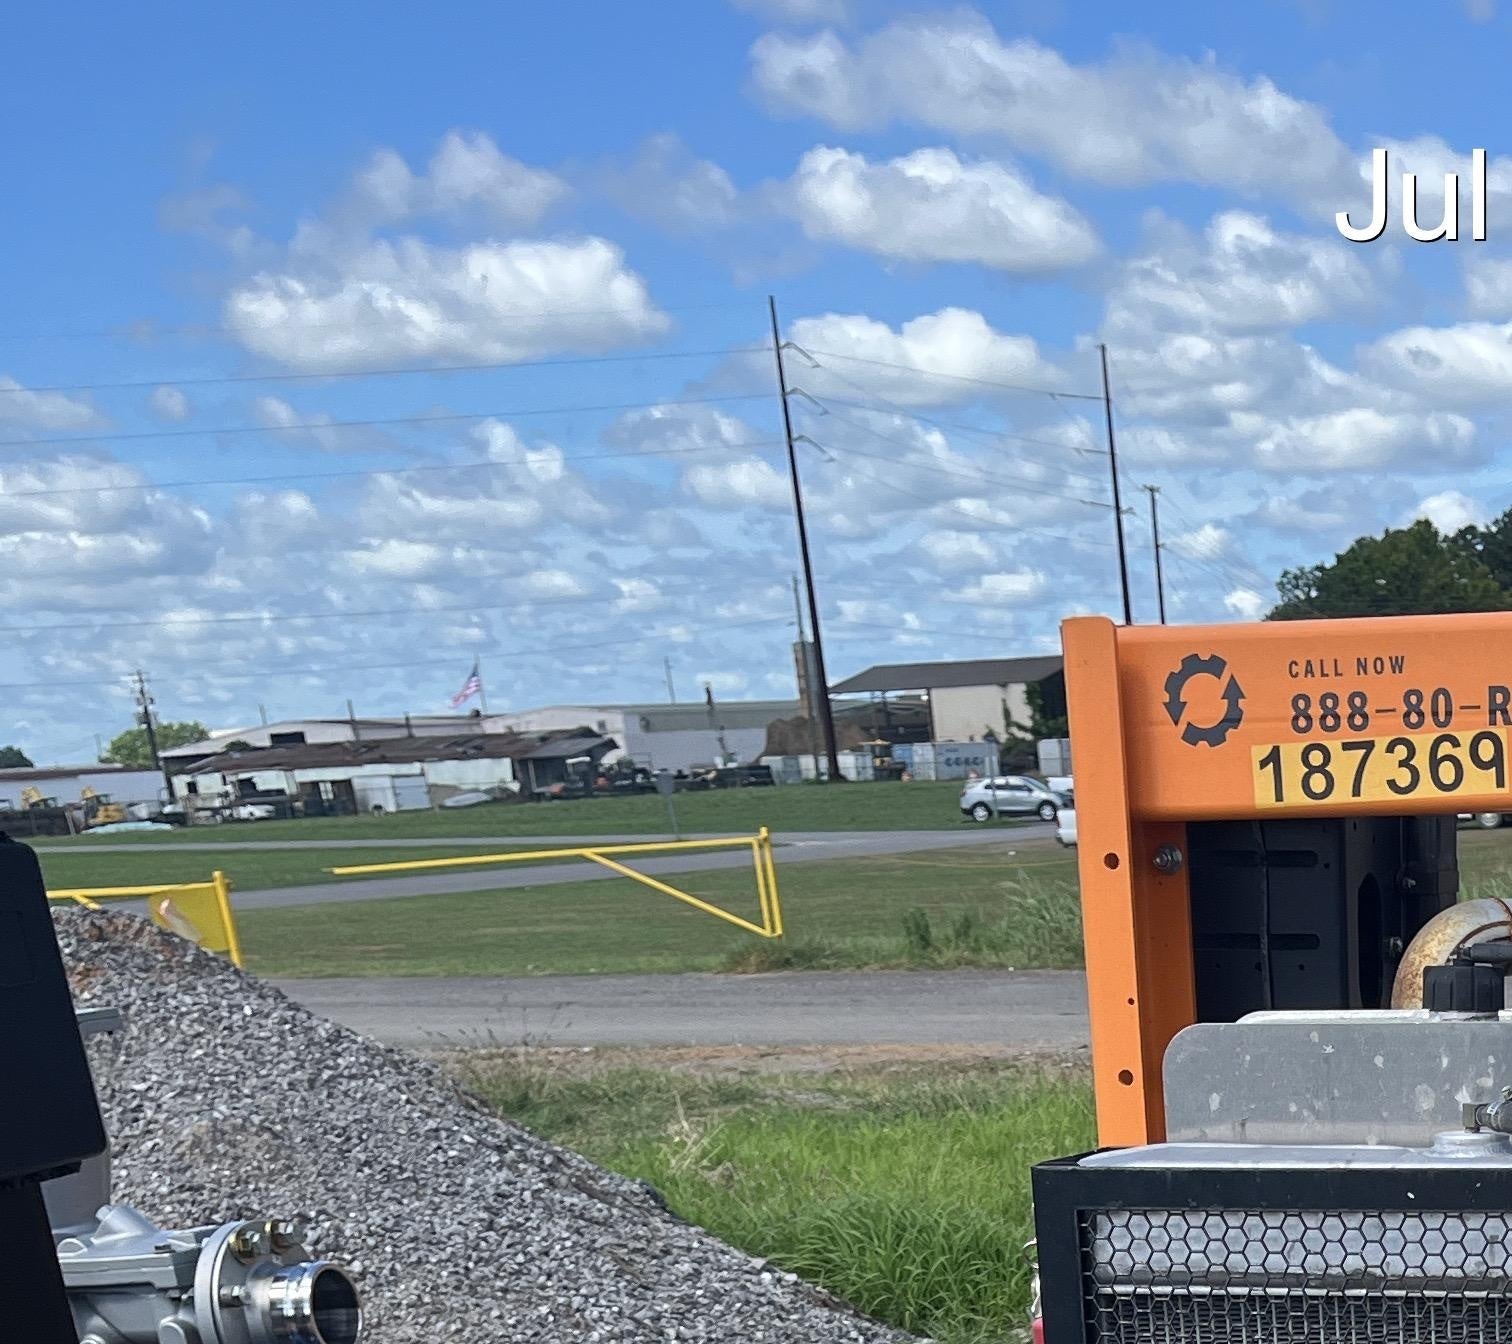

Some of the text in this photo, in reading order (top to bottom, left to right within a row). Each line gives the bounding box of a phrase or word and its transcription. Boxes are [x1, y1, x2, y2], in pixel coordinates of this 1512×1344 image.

[1288, 655, 1406, 679] CALL NOW
[1258, 730, 1507, 803] 187369
